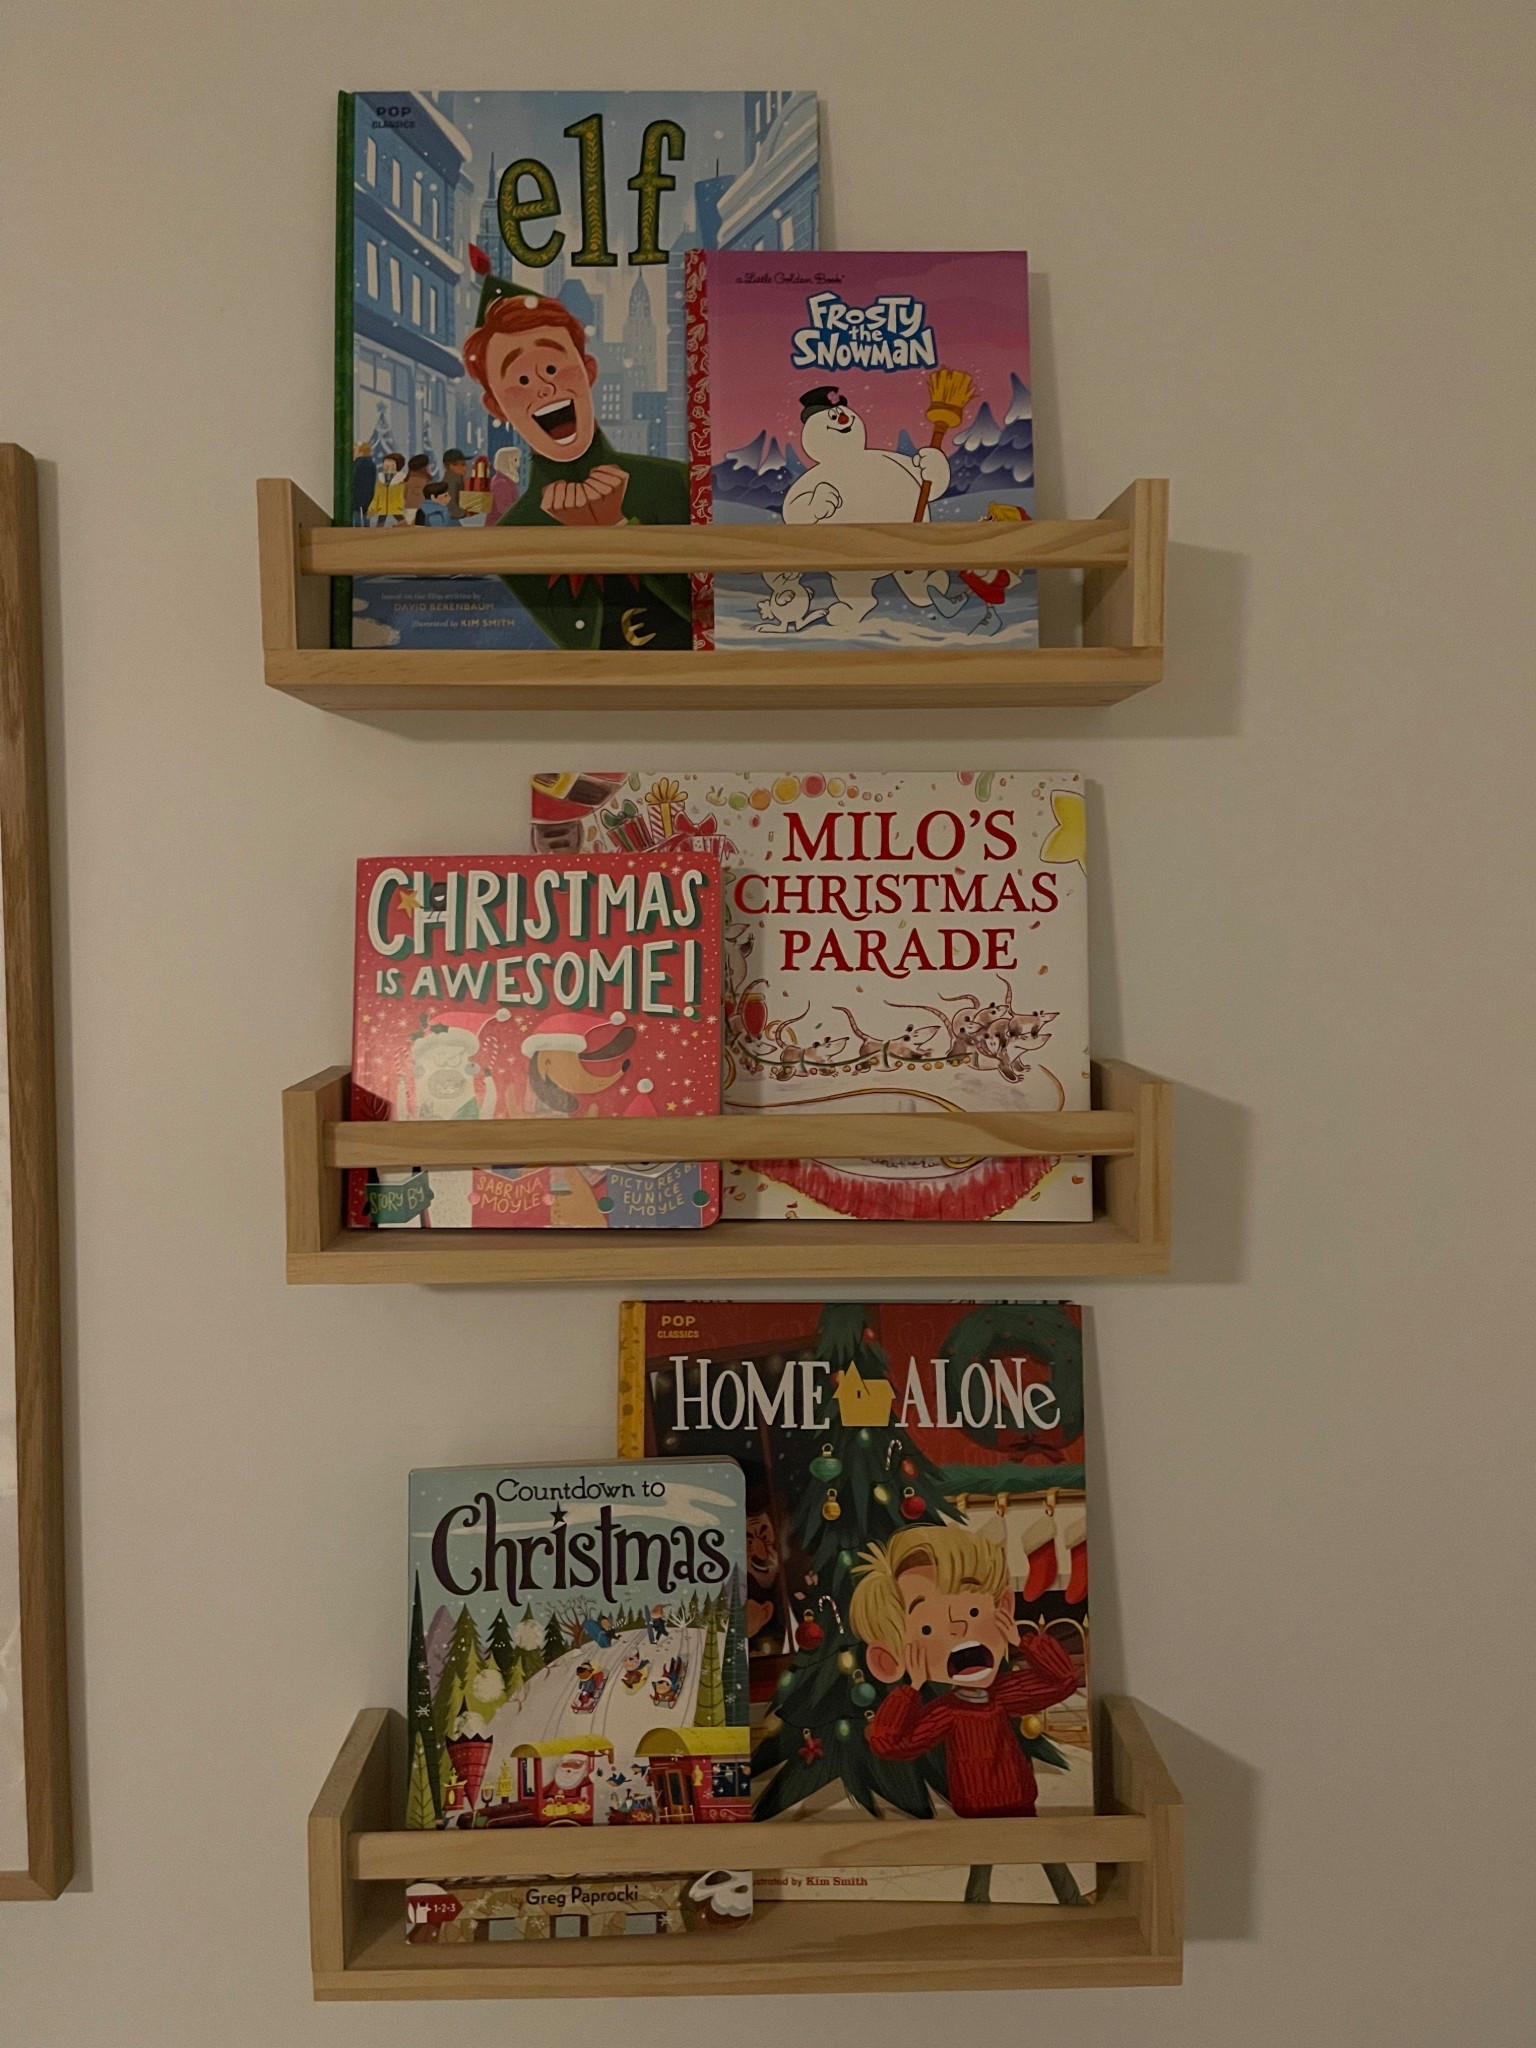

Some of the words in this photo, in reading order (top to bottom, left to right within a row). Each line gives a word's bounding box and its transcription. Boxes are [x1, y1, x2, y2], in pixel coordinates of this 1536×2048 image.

[376, 106, 411, 117] POP
[497, 112, 686, 268] elf
[744, 272, 772, 284] Little
[774, 272, 813, 284] Golden
[808, 291, 924, 337] FROSTY
[849, 324, 884, 342] the
[460, 619, 480, 627] KIM
[482, 619, 515, 627] SMITH
[782, 809, 1018, 863] MILO'S
[733, 871, 1059, 921] CHRISTMAS
[367, 867, 704, 956] CHRISTMAS
[779, 928, 1019, 979] PARADE
[376, 967, 400, 996] IS
[411, 939, 698, 1018] AWESOME!
[477, 1176, 544, 1199] SABRINA
[610, 1167, 681, 1190] PICTURES
[369, 1191, 404, 1214] STORY
[407, 1186, 425, 1210] BY
[480, 1193, 541, 1214] MOYLE
[623, 1182, 681, 1205] EUNICE
[629, 1193, 685, 1217] MOYLE
[661, 1315, 696, 1327] POP
[657, 1330, 700, 1339] CLASSICS
[669, 1355, 832, 1431] HOME
[496, 1476, 635, 1502] Countdown
[641, 1480, 666, 1498] to
[431, 1492, 731, 1607] Christmas
[791, 1877, 802, 1887] by
[806, 1876, 830, 1886] Kim
[833, 1876, 868, 1886] Smith
[526, 1888, 567, 1908] Greg
[572, 1884, 639, 1906] Paprocki
[434, 1904, 456, 1913] 1-2-3
